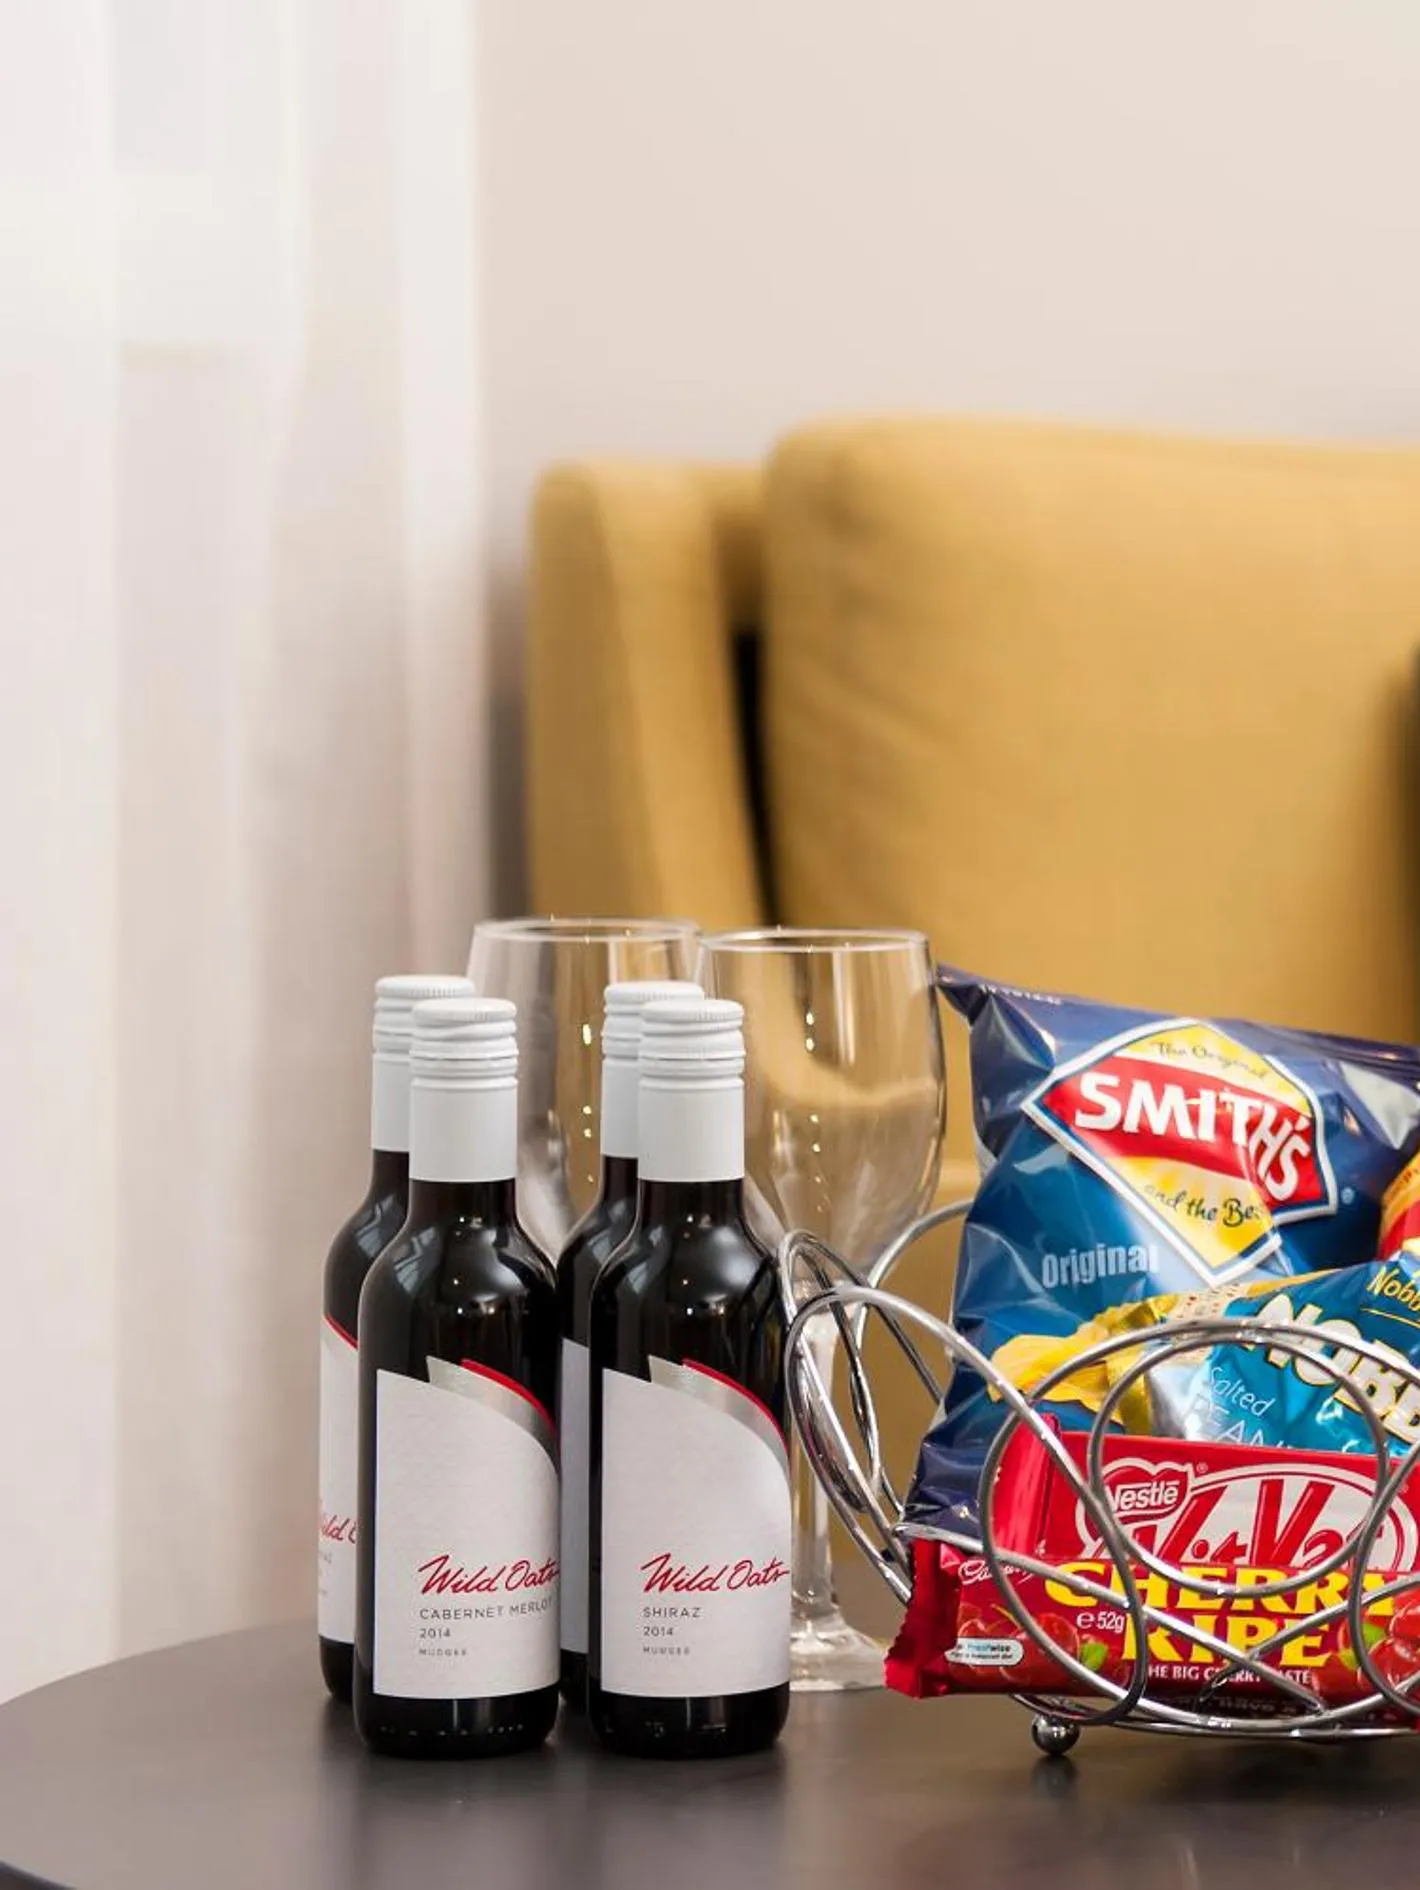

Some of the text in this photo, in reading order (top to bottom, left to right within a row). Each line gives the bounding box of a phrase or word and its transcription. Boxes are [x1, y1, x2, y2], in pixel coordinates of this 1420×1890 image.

[1074, 1071, 1310, 1201] SMITH'S
[1186, 1198, 1218, 1222] the
[1042, 1242, 1159, 1289] Original
[1210, 1366, 1276, 1418] Salted
[418, 1554, 506, 1594] Wild
[640, 1552, 791, 1594] Wild Oats
[1044, 1560, 1400, 1617] CHERRY
[419, 1605, 504, 1620] CABERNET
[643, 1606, 701, 1618] SHIRAZ
[643, 1626, 674, 1637] 2014
[419, 1627, 451, 1639] 2014
[1121, 1613, 1334, 1668] RIPE
[1148, 1666, 1169, 1679] HE
[1172, 1666, 1200, 1681] BIG
